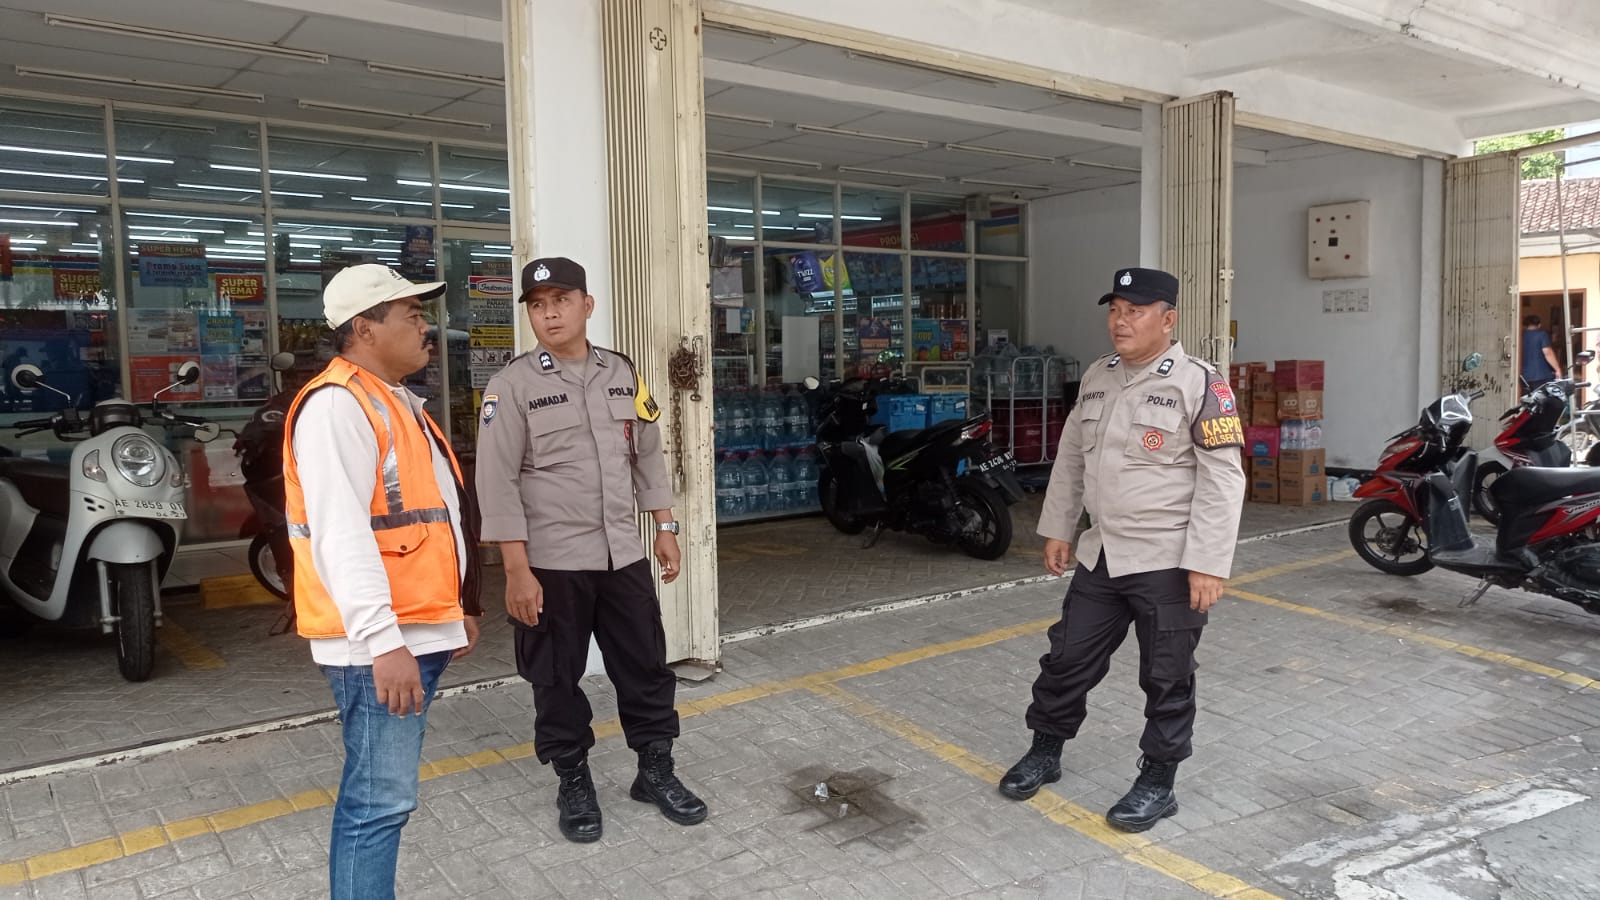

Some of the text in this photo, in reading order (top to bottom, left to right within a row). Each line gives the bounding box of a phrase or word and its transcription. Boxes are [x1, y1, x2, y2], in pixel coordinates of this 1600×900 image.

[141, 244, 171, 253] SUPER
[60, 273, 101, 283] SUPER
[221, 278, 257, 287] SUPER
[60, 283, 101, 292] HEMAT
[220, 286, 258, 295] HEMAT
[1147, 395, 1178, 409] POLRI
[1204, 433, 1236, 448] POLSEK
[115, 499, 129, 507] AE
